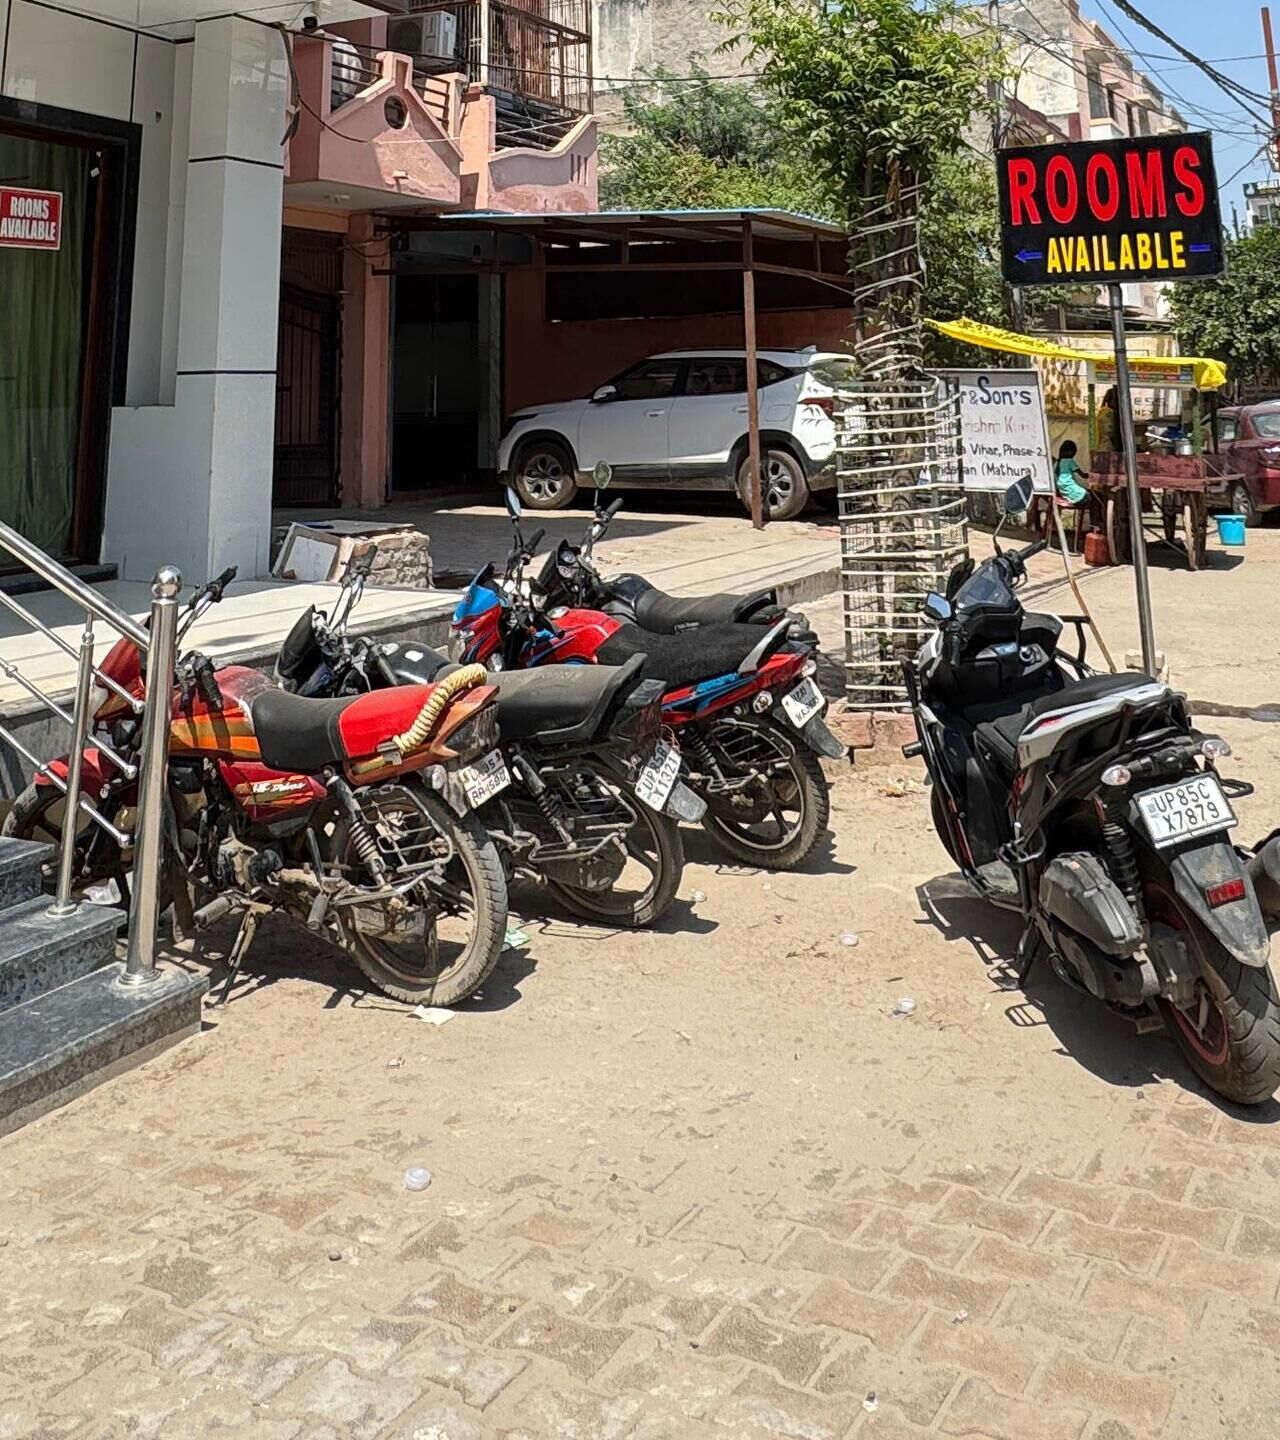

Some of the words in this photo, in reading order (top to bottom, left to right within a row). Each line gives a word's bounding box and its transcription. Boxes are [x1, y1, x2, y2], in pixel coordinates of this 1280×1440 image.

[1007, 144, 1205, 226] ROOMS
[10, 196, 50, 220] ROOMS
[0, 217, 57, 241] AVAILABLE
[1046, 230, 1187, 274] AVAILABLE
[1153, 782, 1210, 813] UP85C
[1162, 801, 1220, 833] X7879
